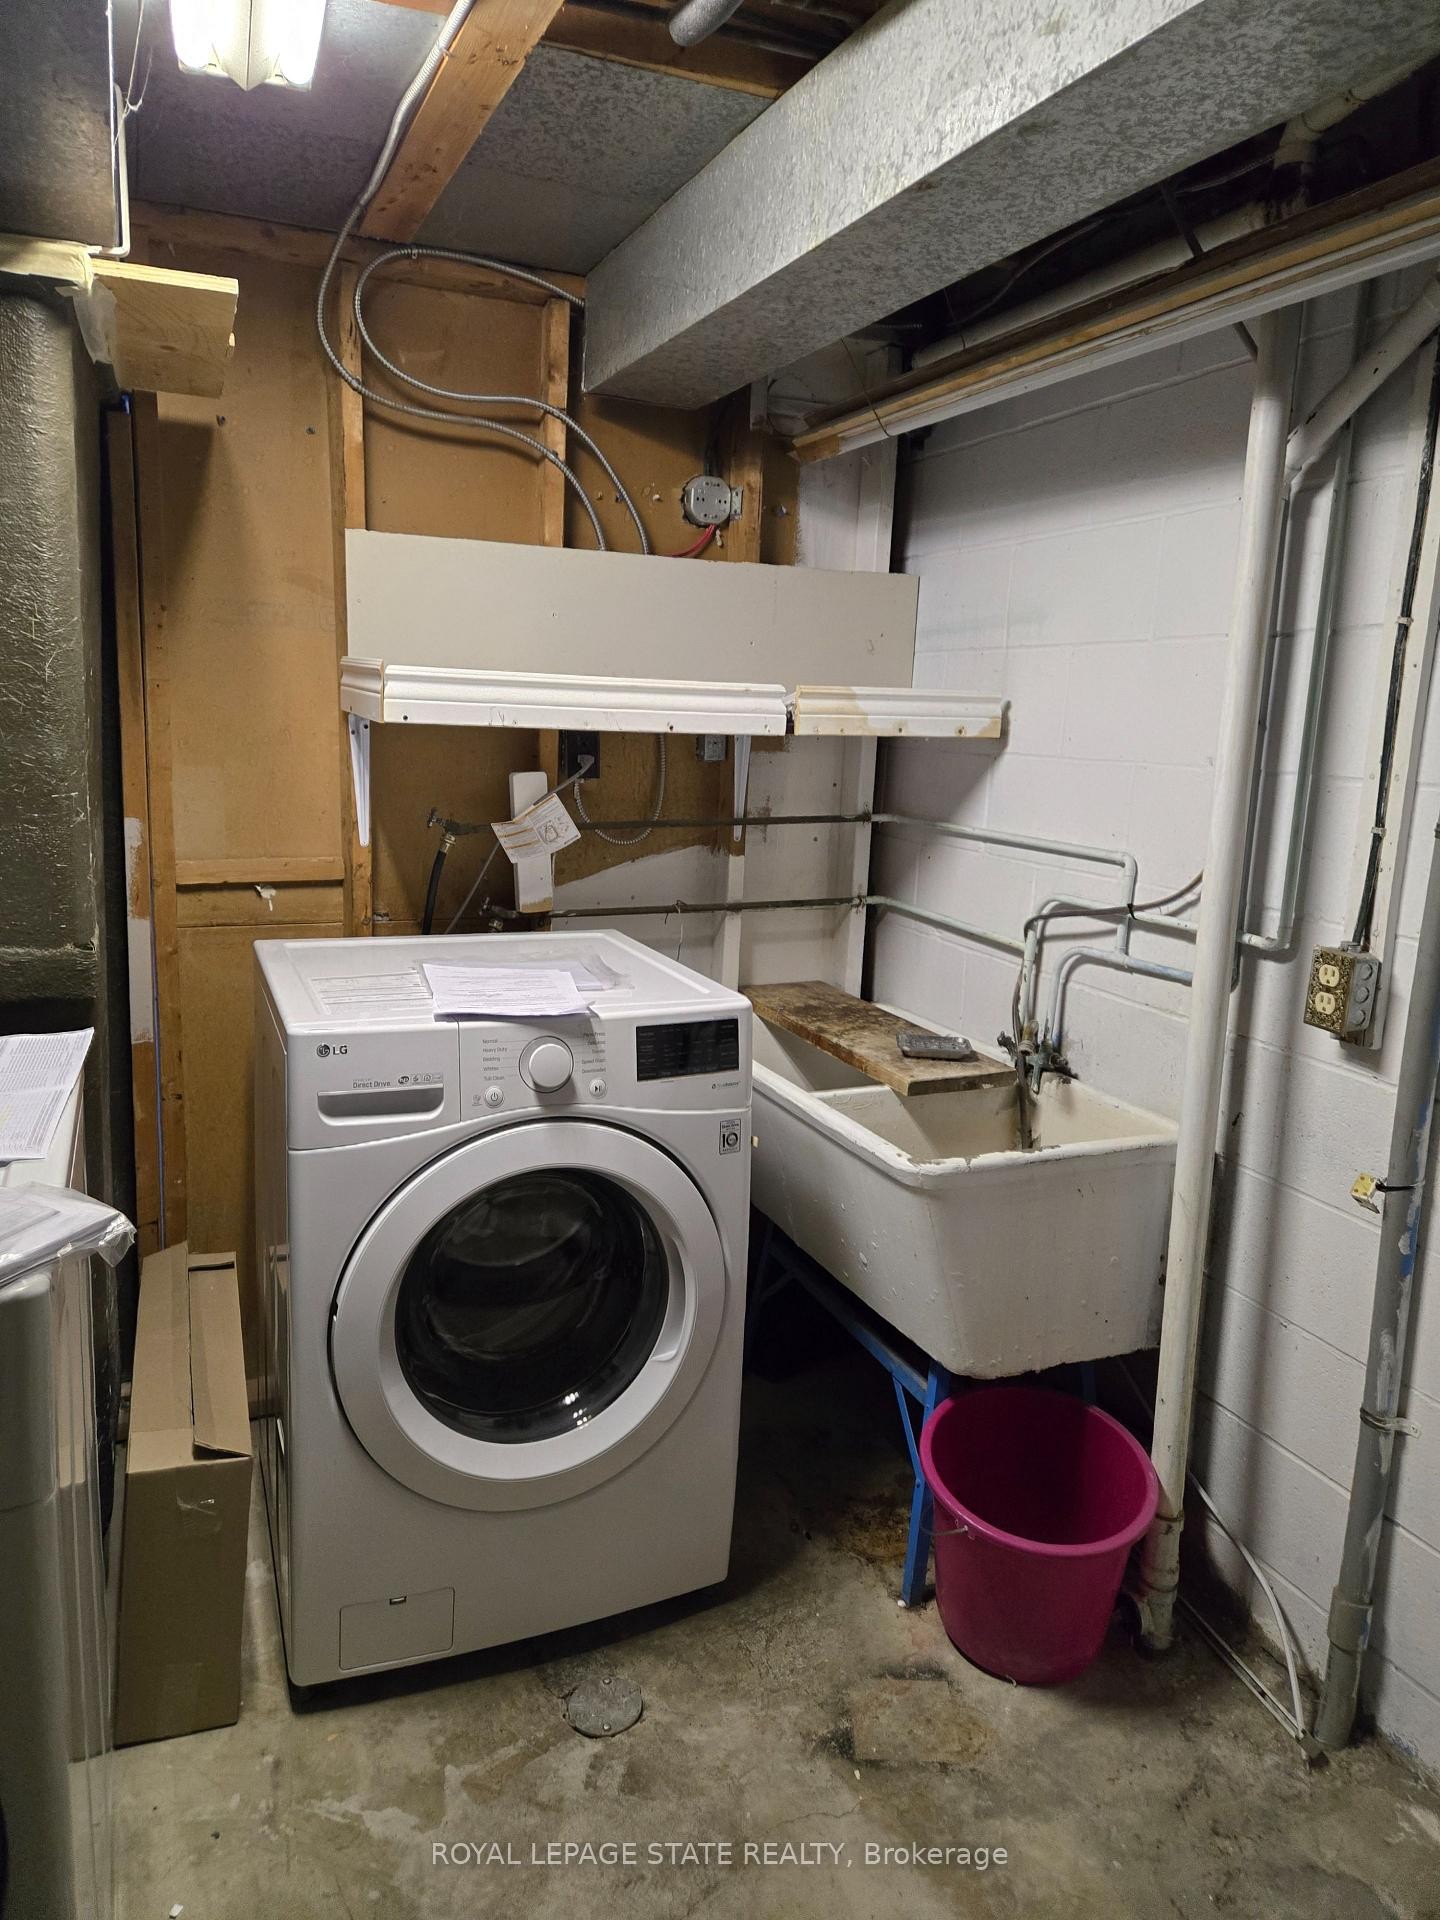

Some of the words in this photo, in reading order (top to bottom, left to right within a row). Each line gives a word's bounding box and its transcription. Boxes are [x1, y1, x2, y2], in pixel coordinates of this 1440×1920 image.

[332, 1045, 348, 1055] LG
[352, 1081, 373, 1089] Direct
[373, 1079, 391, 1088] Drive
